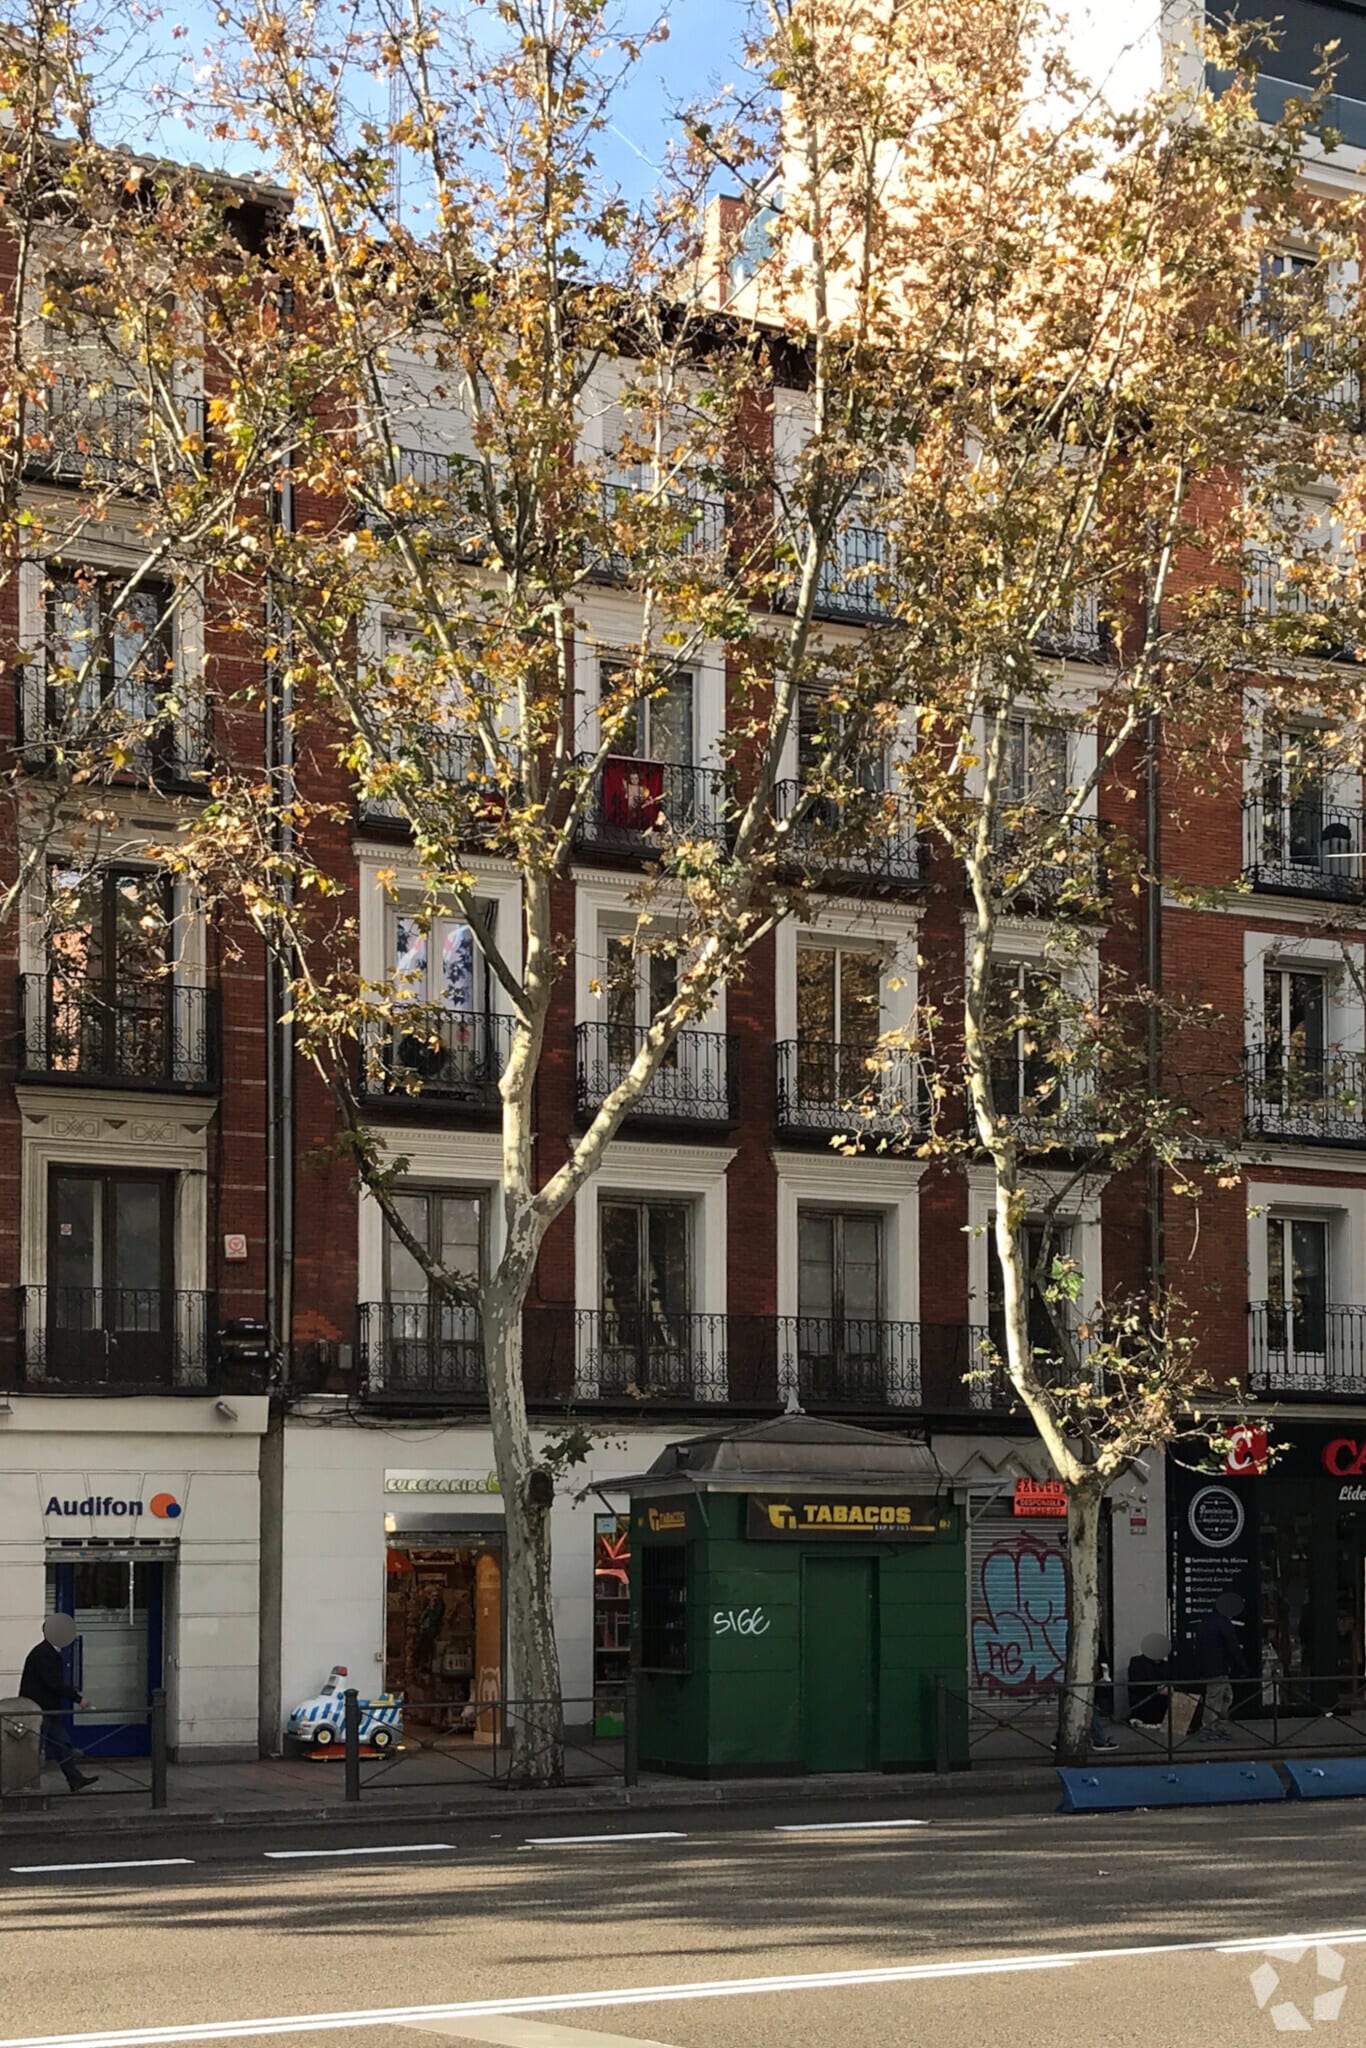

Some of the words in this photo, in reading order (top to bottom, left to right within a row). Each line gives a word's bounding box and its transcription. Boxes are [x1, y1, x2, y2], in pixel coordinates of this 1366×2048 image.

[387, 1479, 487, 1491] EUREKAKIDS
[45, 1496, 143, 1516] Audifon
[803, 1505, 911, 1524] TABACOS
